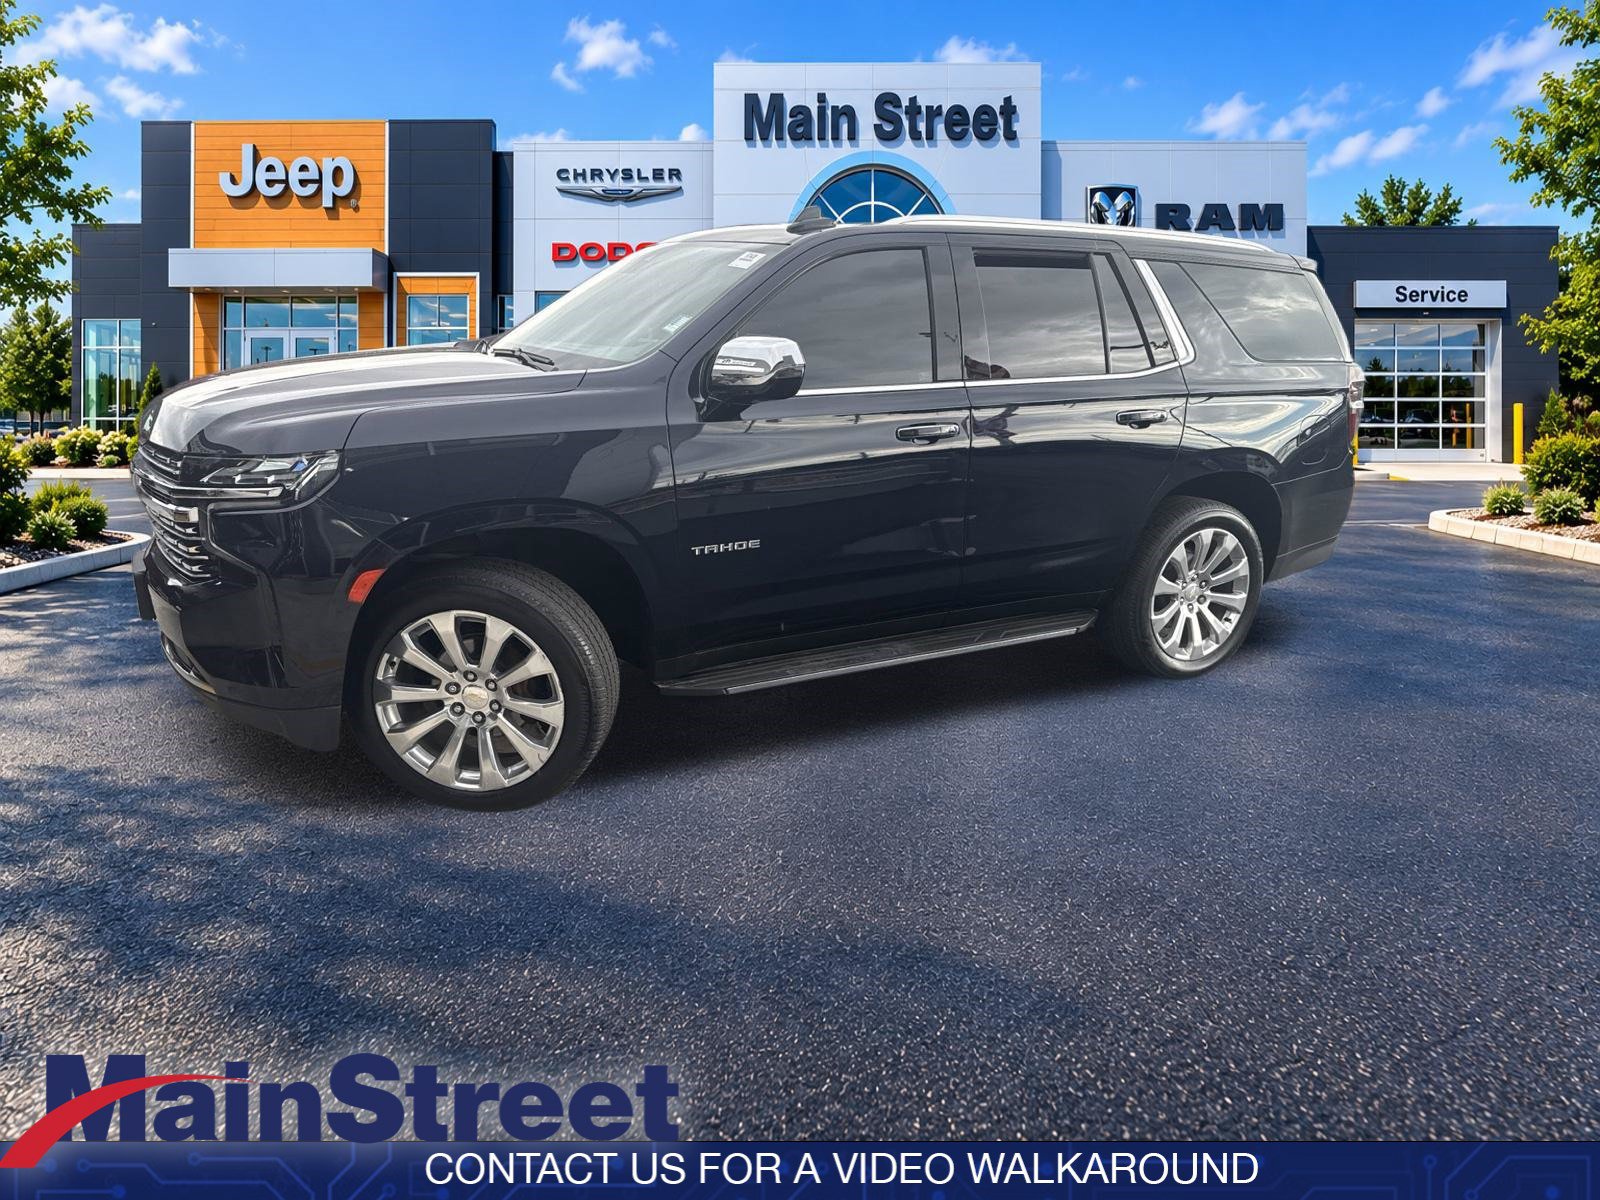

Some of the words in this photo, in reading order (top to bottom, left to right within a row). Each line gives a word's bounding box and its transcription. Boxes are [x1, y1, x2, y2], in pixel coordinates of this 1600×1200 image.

[743, 92, 857, 141] Main
[873, 91, 1018, 142] Street
[219, 143, 355, 208] Jeep
[556, 168, 683, 182] CHRYSLER
[1155, 203, 1284, 231] RAM
[1395, 285, 1469, 303] Service
[691, 539, 761, 556] TAHOE
